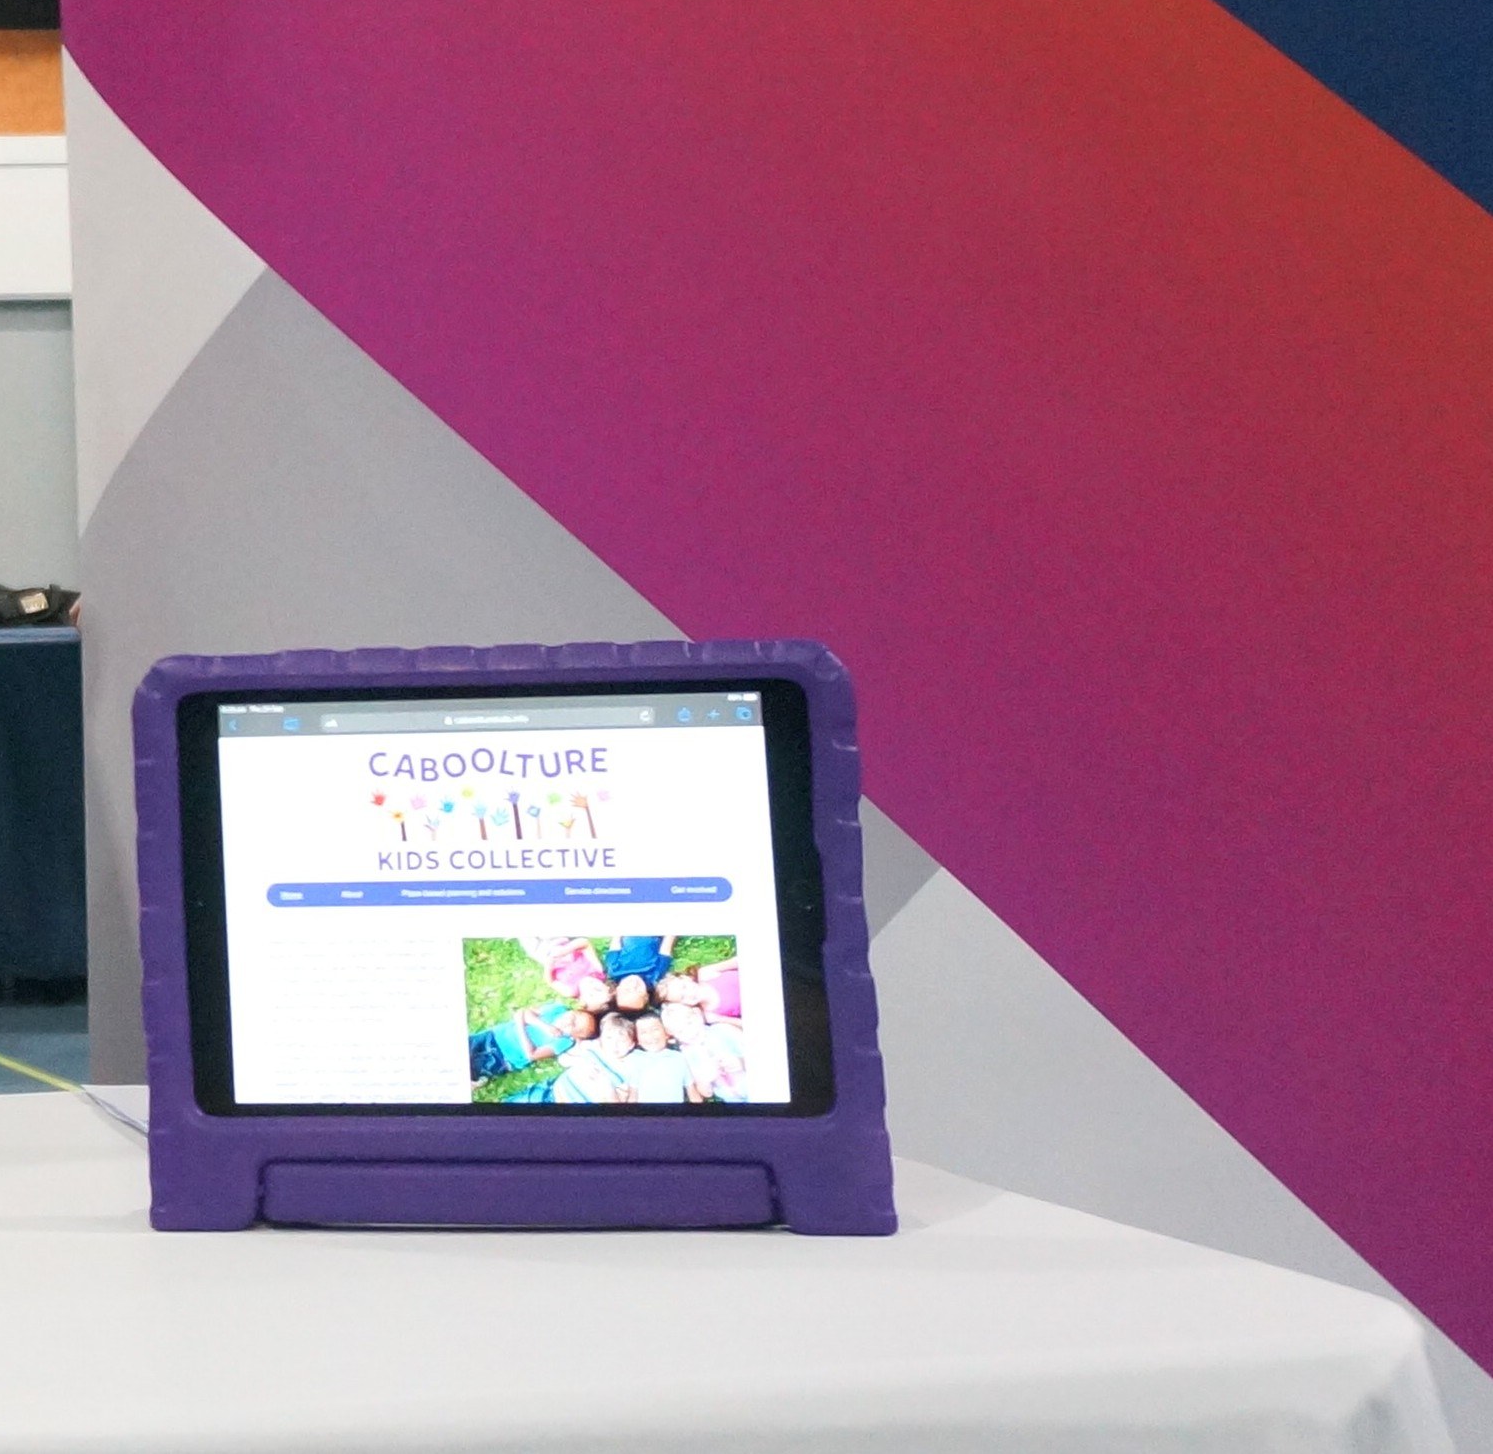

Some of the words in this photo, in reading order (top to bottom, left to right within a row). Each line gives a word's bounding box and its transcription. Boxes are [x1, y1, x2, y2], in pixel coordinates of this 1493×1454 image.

[369, 748, 608, 782] CABOOLTURE
[378, 851, 440, 871] KIDS
[449, 848, 616, 870] COLLECTIVE
